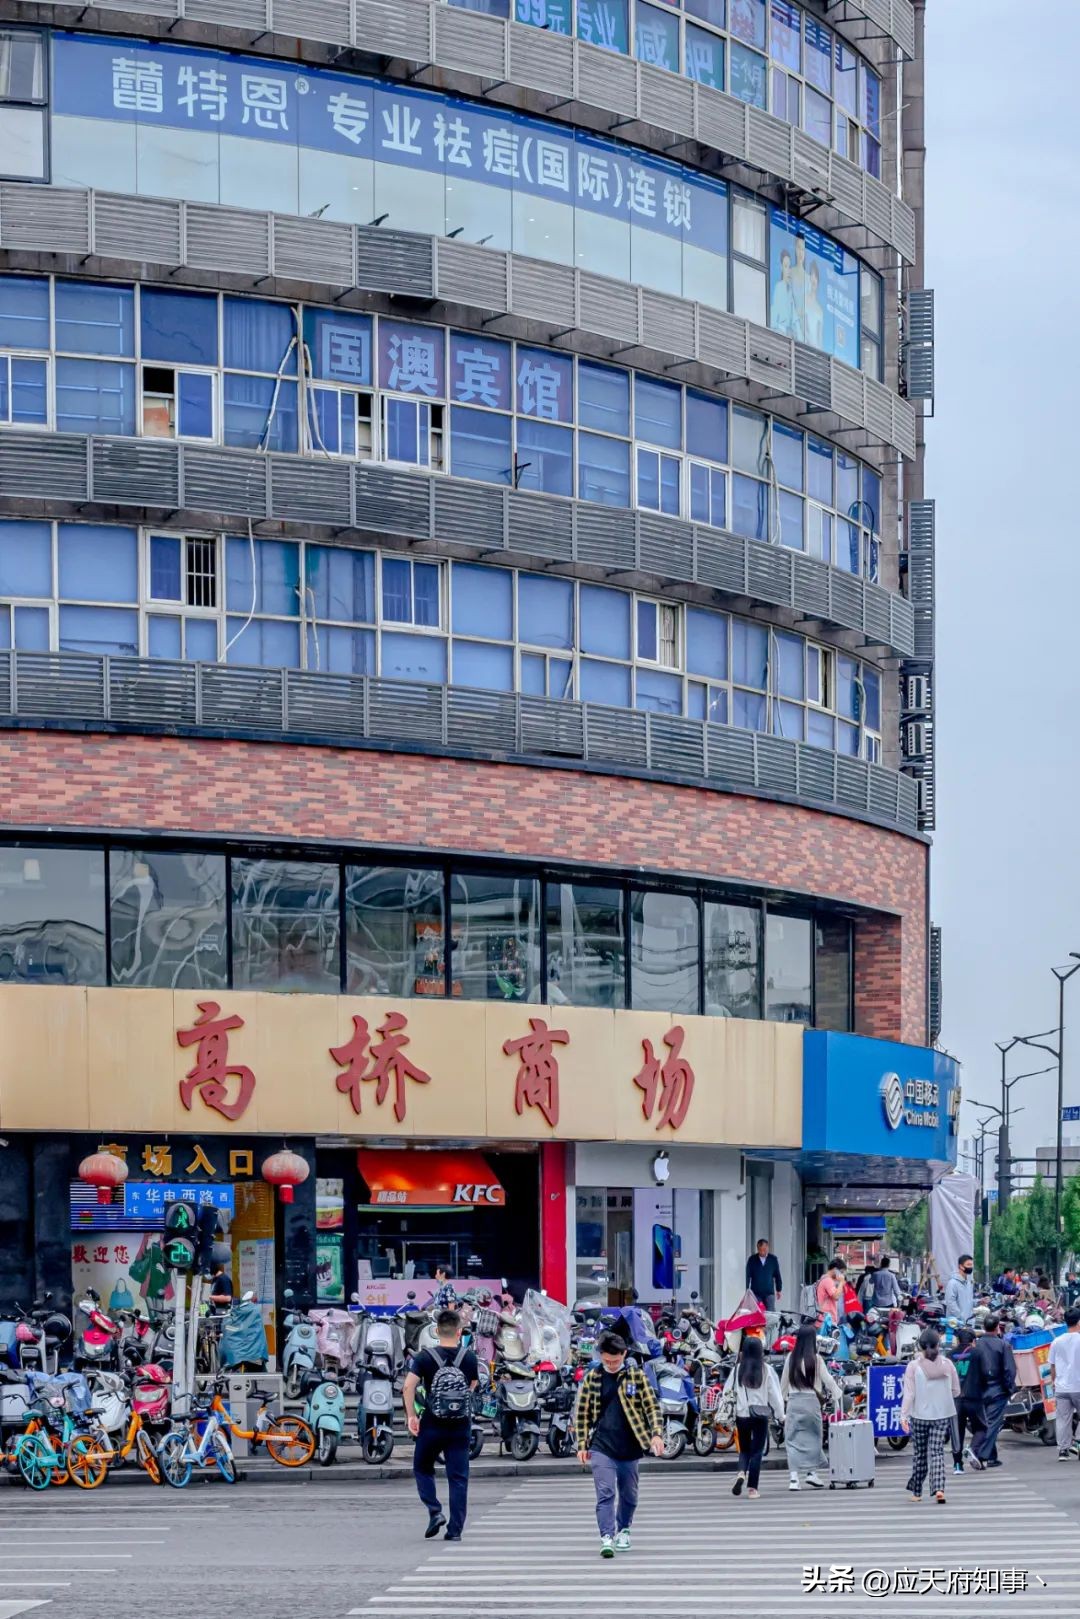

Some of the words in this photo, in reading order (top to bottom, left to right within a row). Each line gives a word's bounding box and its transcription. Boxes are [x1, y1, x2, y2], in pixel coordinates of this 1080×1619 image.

[321, 323, 561, 420] 国澳宾馆
[177, 1002, 694, 1130] 高桥商场
[453, 1184, 501, 1203] KFC
